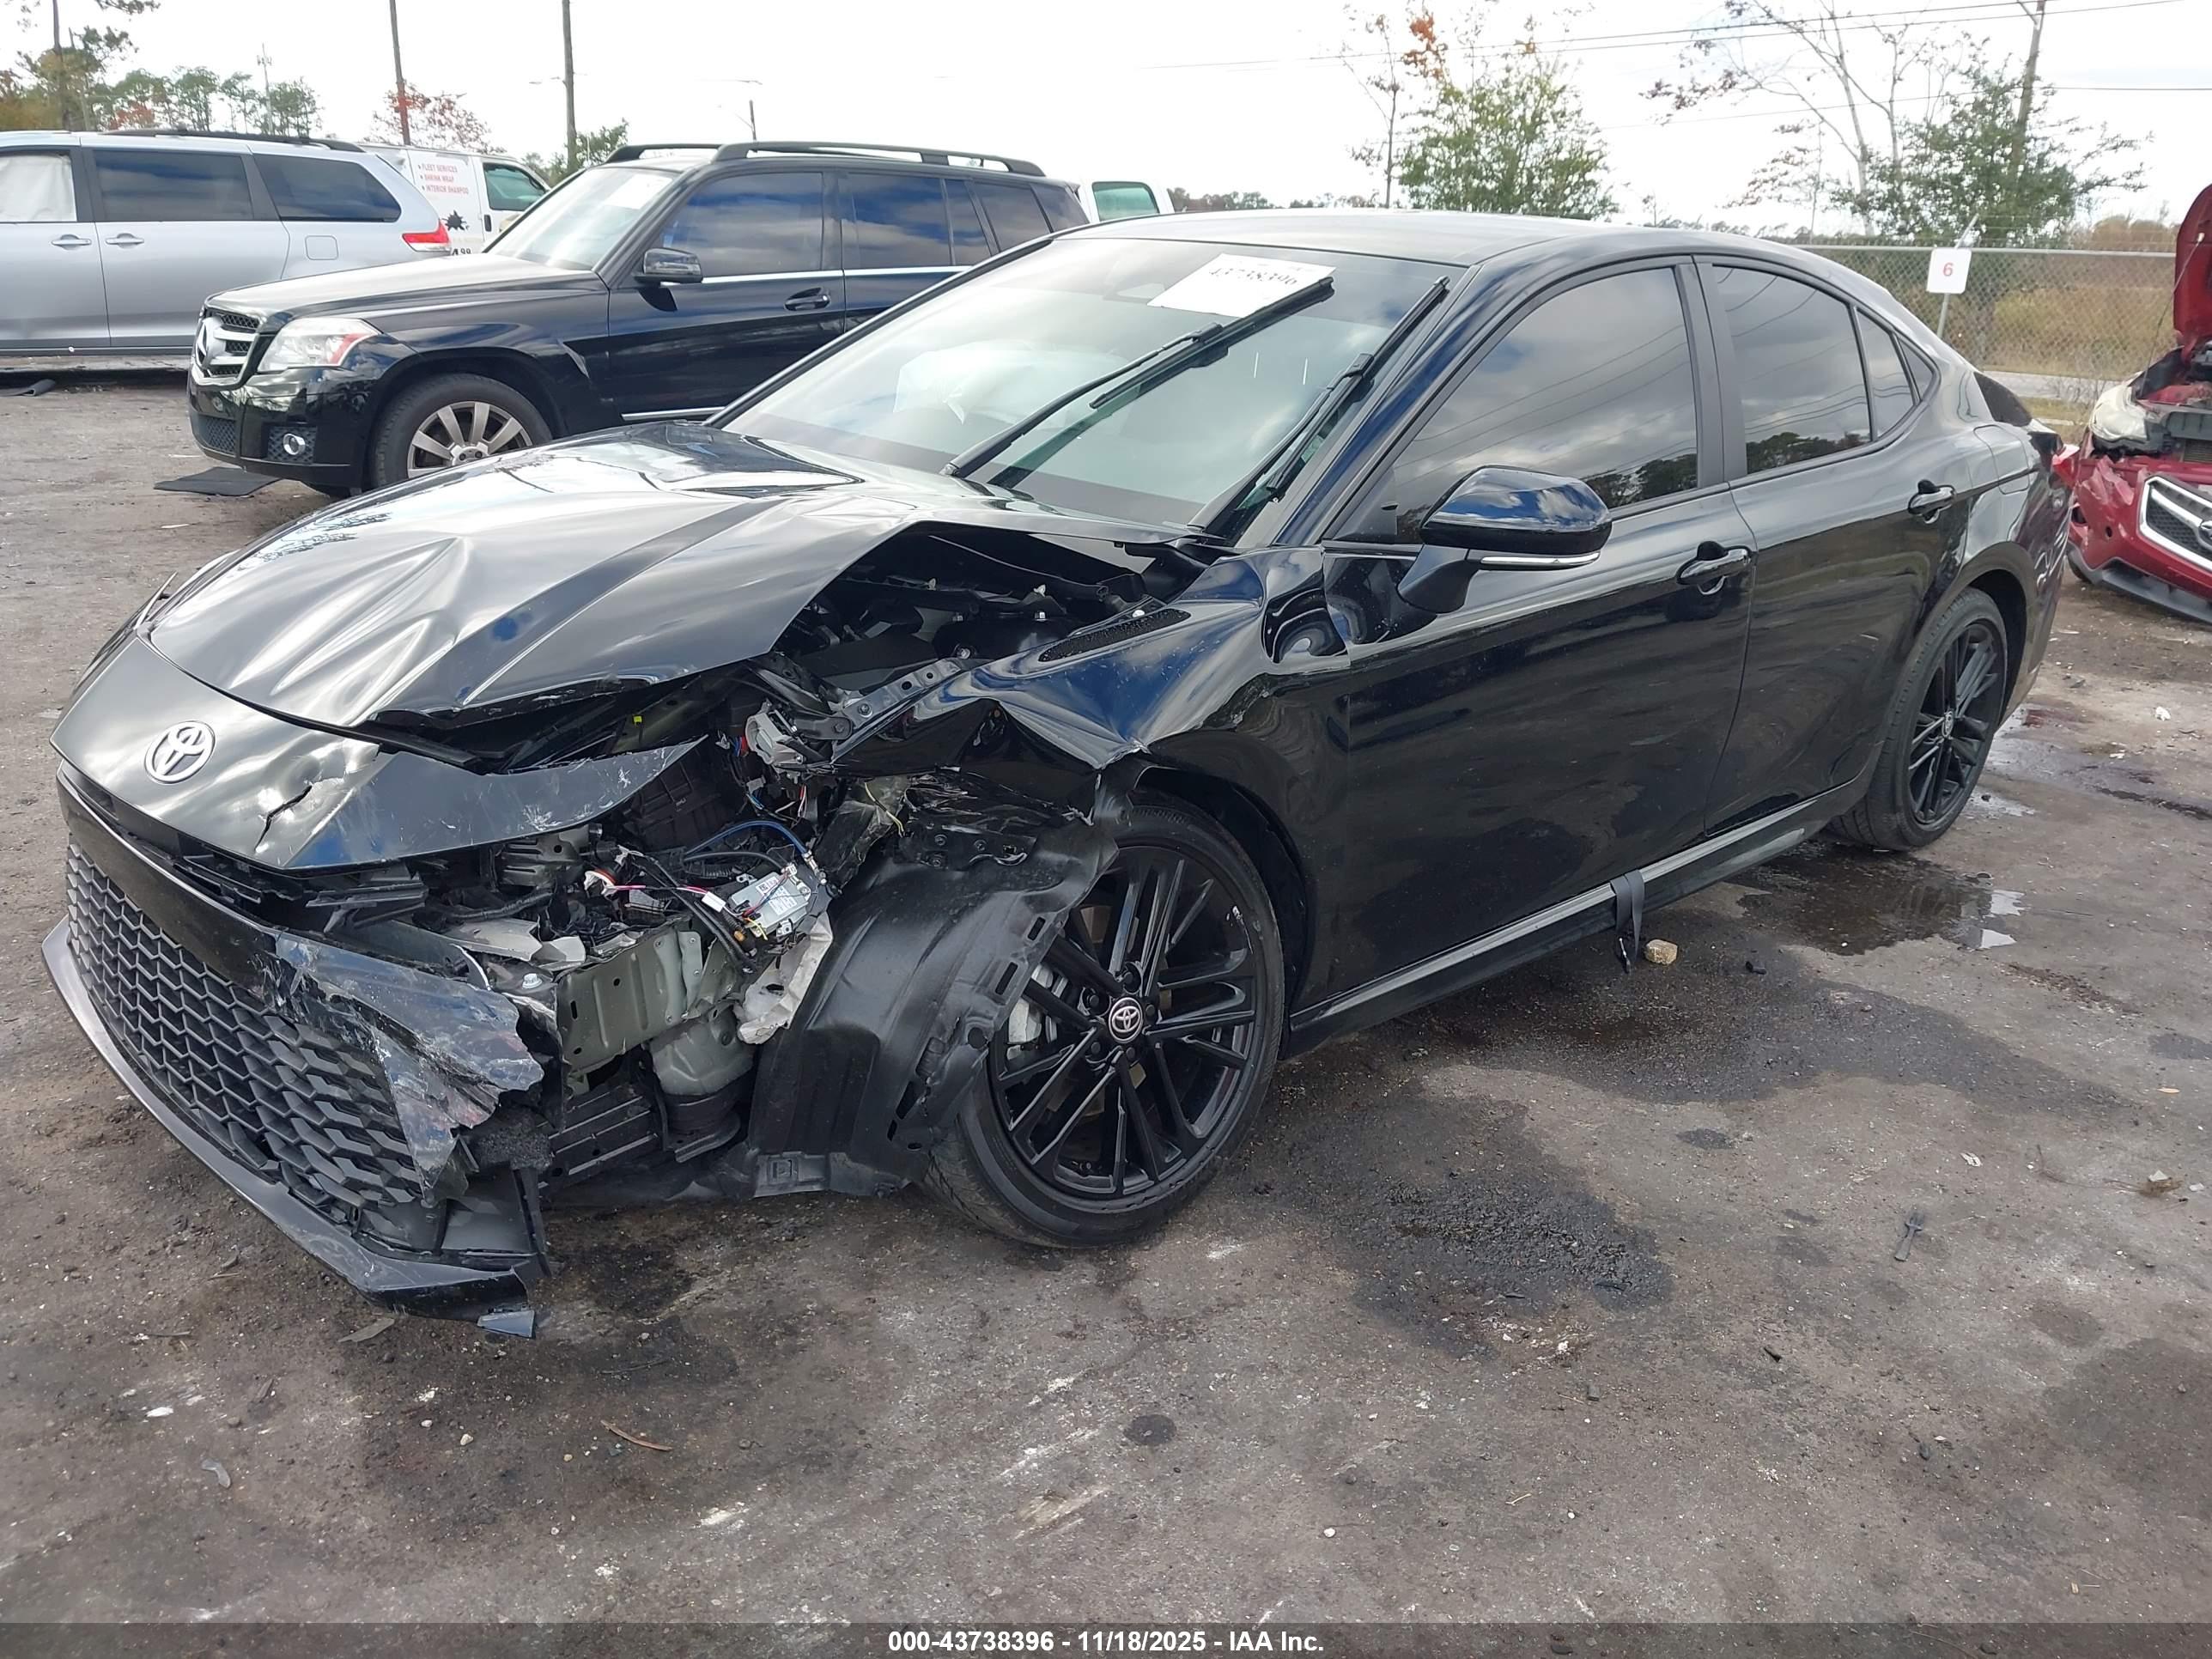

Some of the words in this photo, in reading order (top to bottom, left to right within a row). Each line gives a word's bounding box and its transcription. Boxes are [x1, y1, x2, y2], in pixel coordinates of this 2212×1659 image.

[422, 163, 435, 172] FLEET
[436, 164, 458, 173] SERVICES
[426, 185, 447, 193] INTERIOR
[447, 185, 469, 195] SHAMPOO
[1943, 262, 1954, 276] 6
